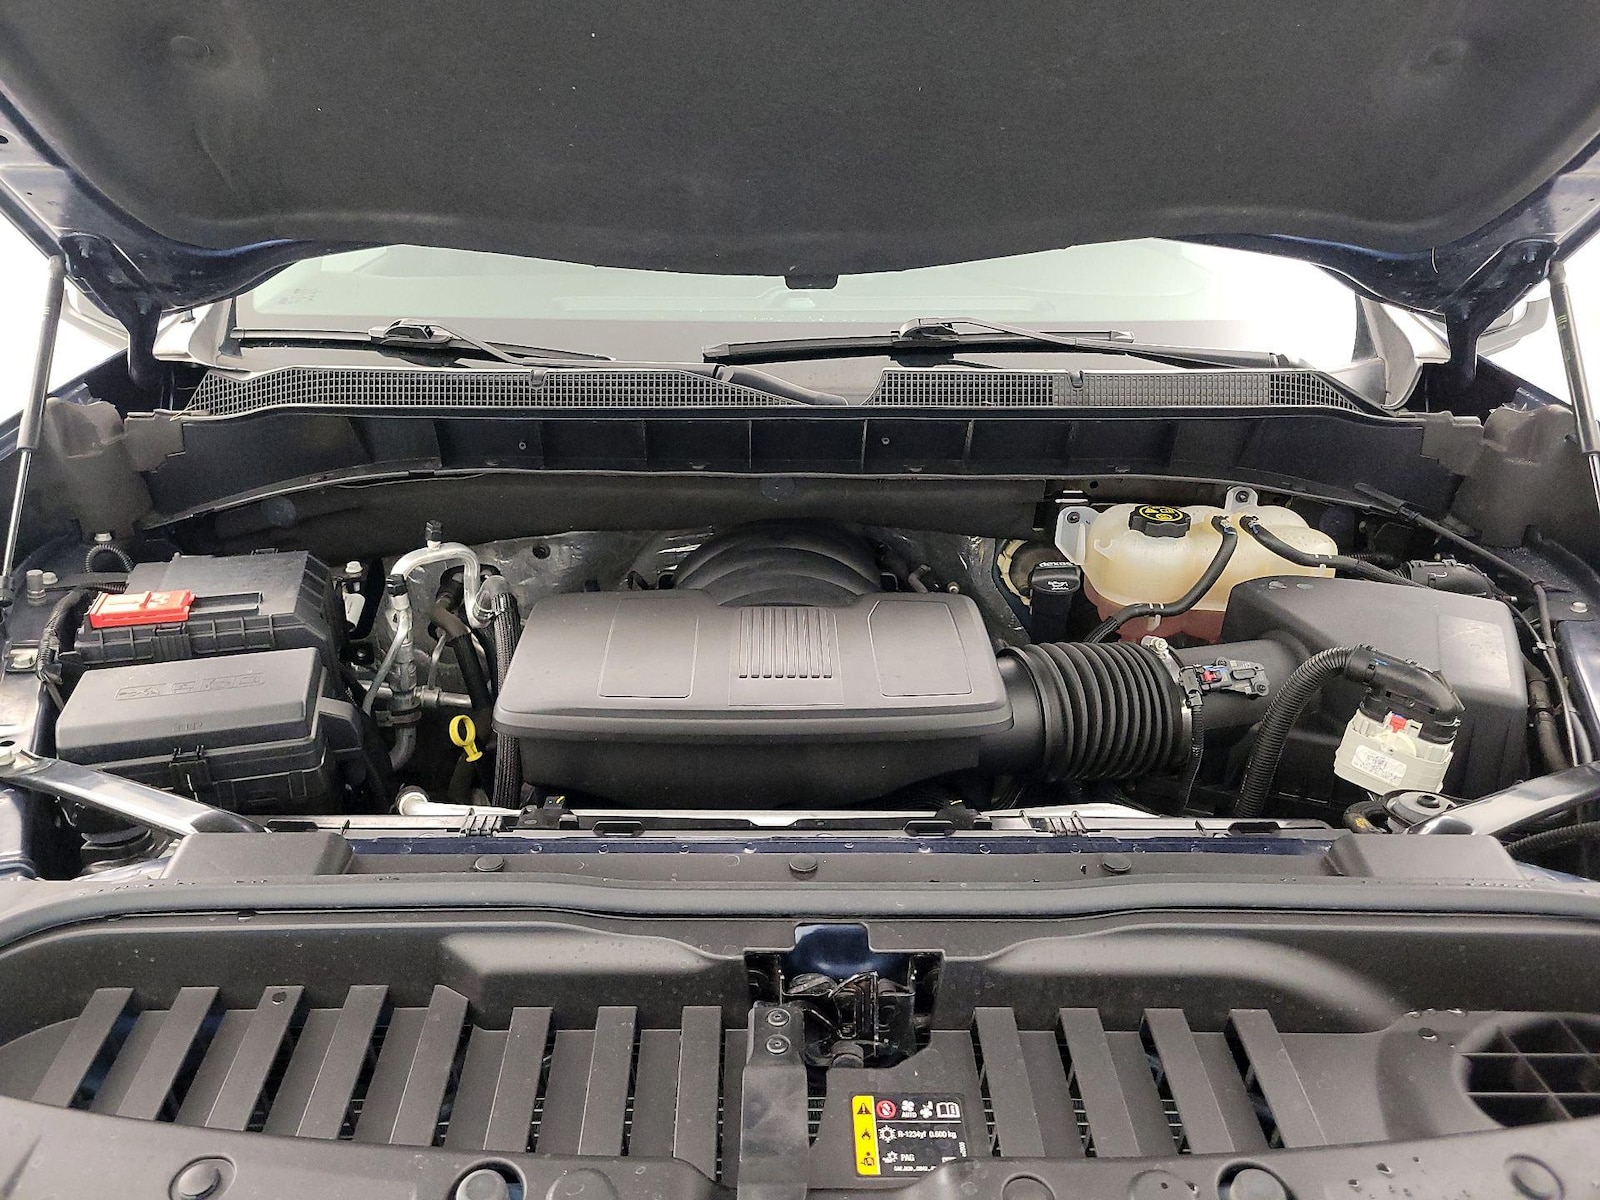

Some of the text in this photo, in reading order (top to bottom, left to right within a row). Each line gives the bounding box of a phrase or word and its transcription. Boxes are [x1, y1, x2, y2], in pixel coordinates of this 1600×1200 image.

[898, 1130, 927, 1139] R-1234yf
[948, 1131, 957, 1139] kg
[900, 1154, 915, 1162] PAG
